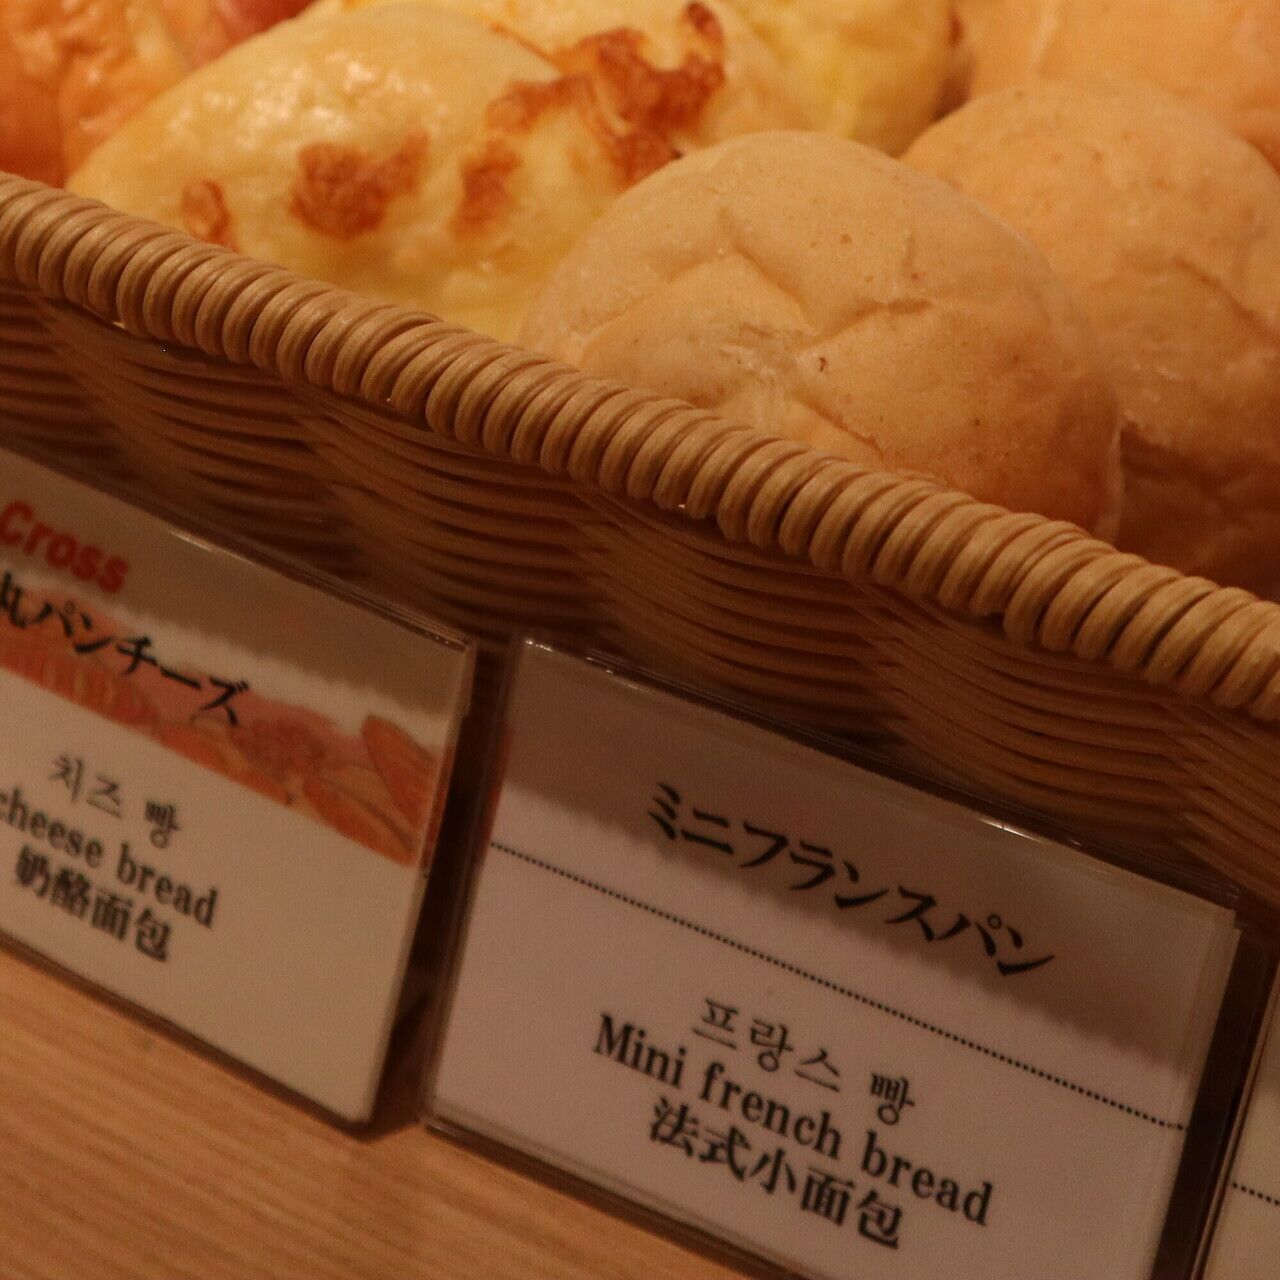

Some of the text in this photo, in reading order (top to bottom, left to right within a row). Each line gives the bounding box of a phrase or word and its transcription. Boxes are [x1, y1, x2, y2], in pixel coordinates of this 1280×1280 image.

[48, 753, 181, 849] 치즈 빵
[14, 846, 173, 964] 奶酪面包
[115, 842, 219, 930] bread
[646, 780, 1055, 977] ミニフランスパン
[591, 1012, 994, 1227] Mini french bread
[691, 995, 916, 1126] 프랑스 빵
[647, 1096, 902, 1250] 法式小面包
